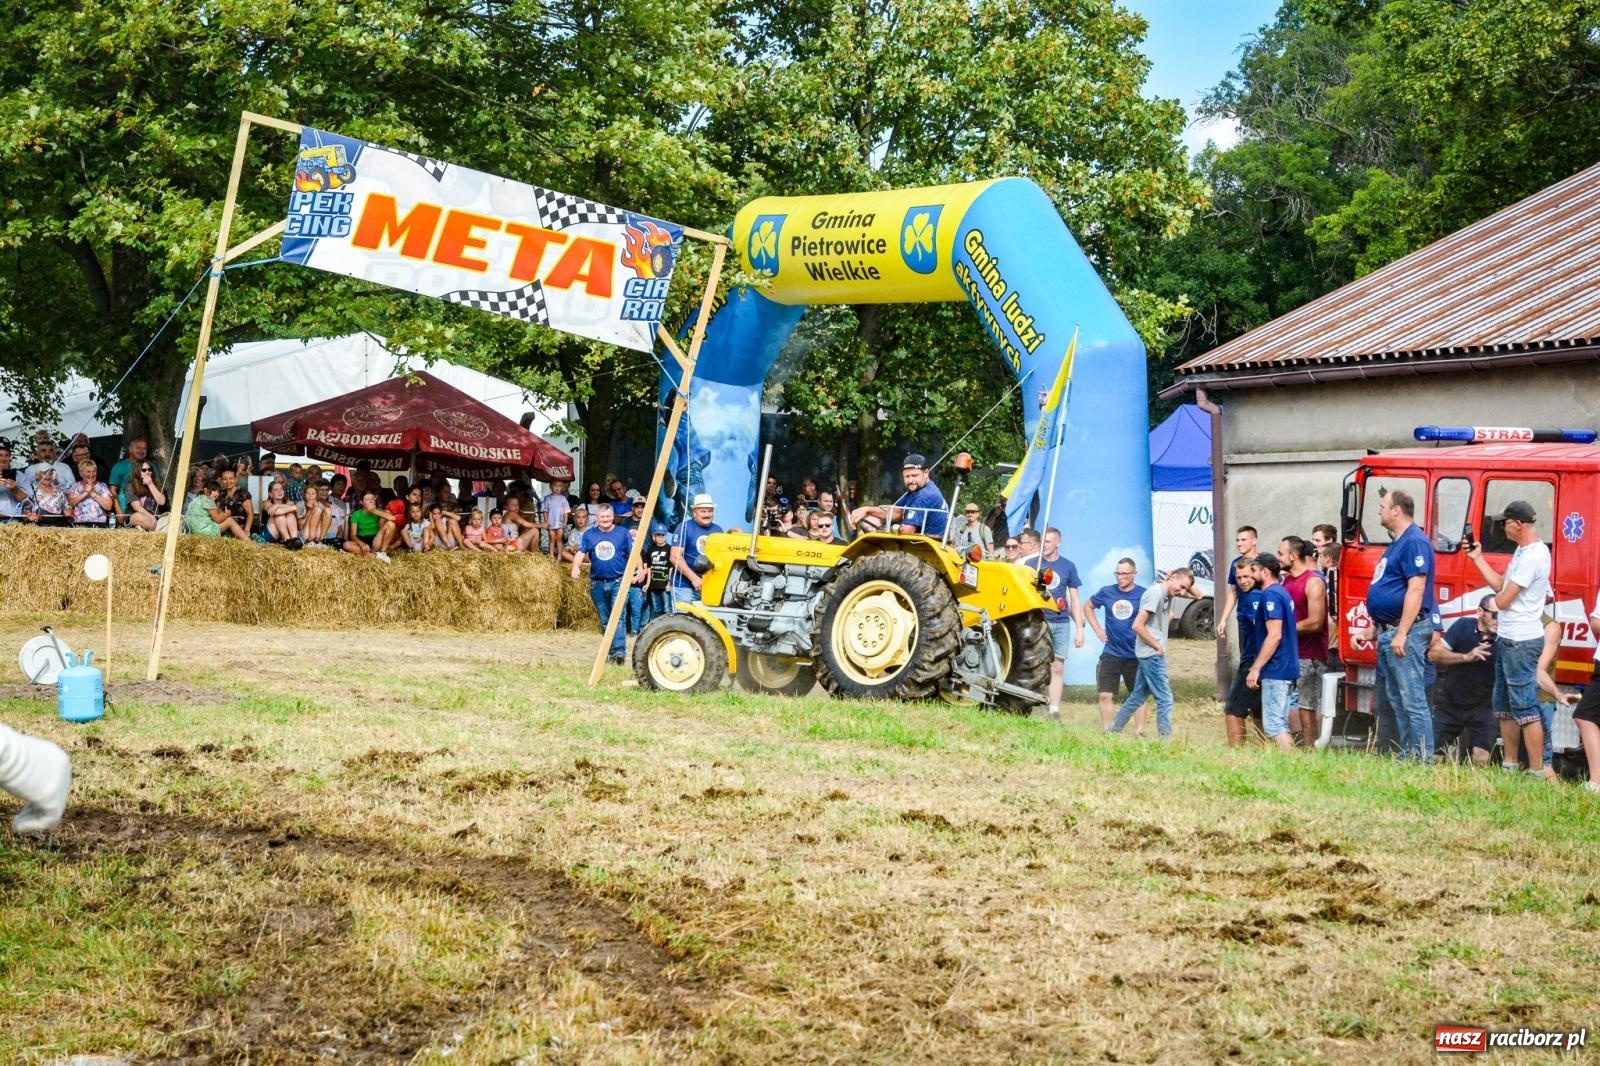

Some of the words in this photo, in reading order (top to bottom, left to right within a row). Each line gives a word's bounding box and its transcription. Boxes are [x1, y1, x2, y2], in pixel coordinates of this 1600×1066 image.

[811, 210, 876, 230] Gmina
[351, 192, 616, 299] META
[791, 233, 887, 256] Pietrowice
[804, 260, 881, 281] Wielkie
[964, 229, 1007, 301] Gmina
[1001, 291, 1045, 355] ludzi
[954, 260, 1021, 374] aktywnych
[306, 428, 403, 446] RACIBORSKIE
[429, 435, 522, 460] RACIBORSKIE
